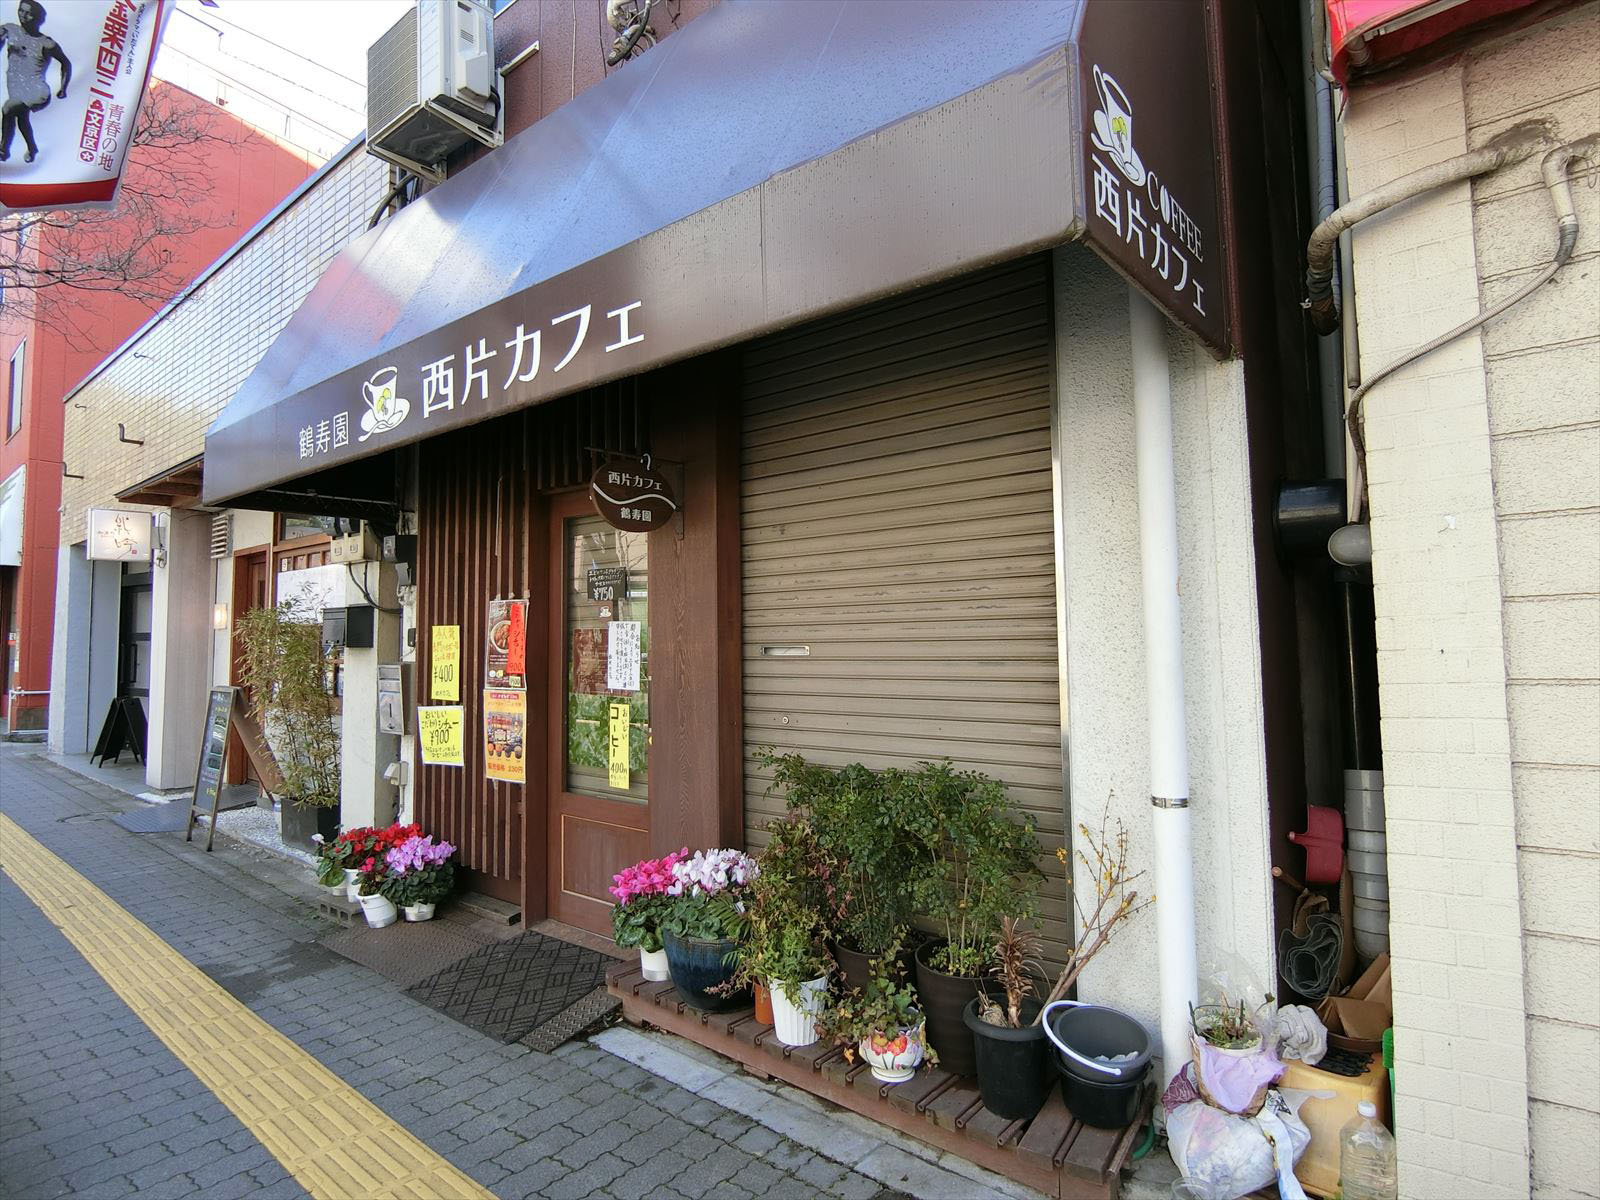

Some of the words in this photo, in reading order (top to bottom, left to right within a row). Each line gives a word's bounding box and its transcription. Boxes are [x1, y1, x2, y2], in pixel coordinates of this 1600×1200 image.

[82, 111, 104, 149] 文京区
[98, 104, 125, 171] 青春の地
[1092, 154, 1206, 317] 西片カフェ
[299, 411, 349, 460] 鶴寿園
[420, 300, 645, 418] 西片カフェ
[608, 471, 663, 491] 西片カフェ
[620, 507, 652, 522] 鶴寿園
[433, 664, 454, 684] ¥400
[429, 729, 450, 746] ¥900
[611, 706, 619, 757] コーヒー
